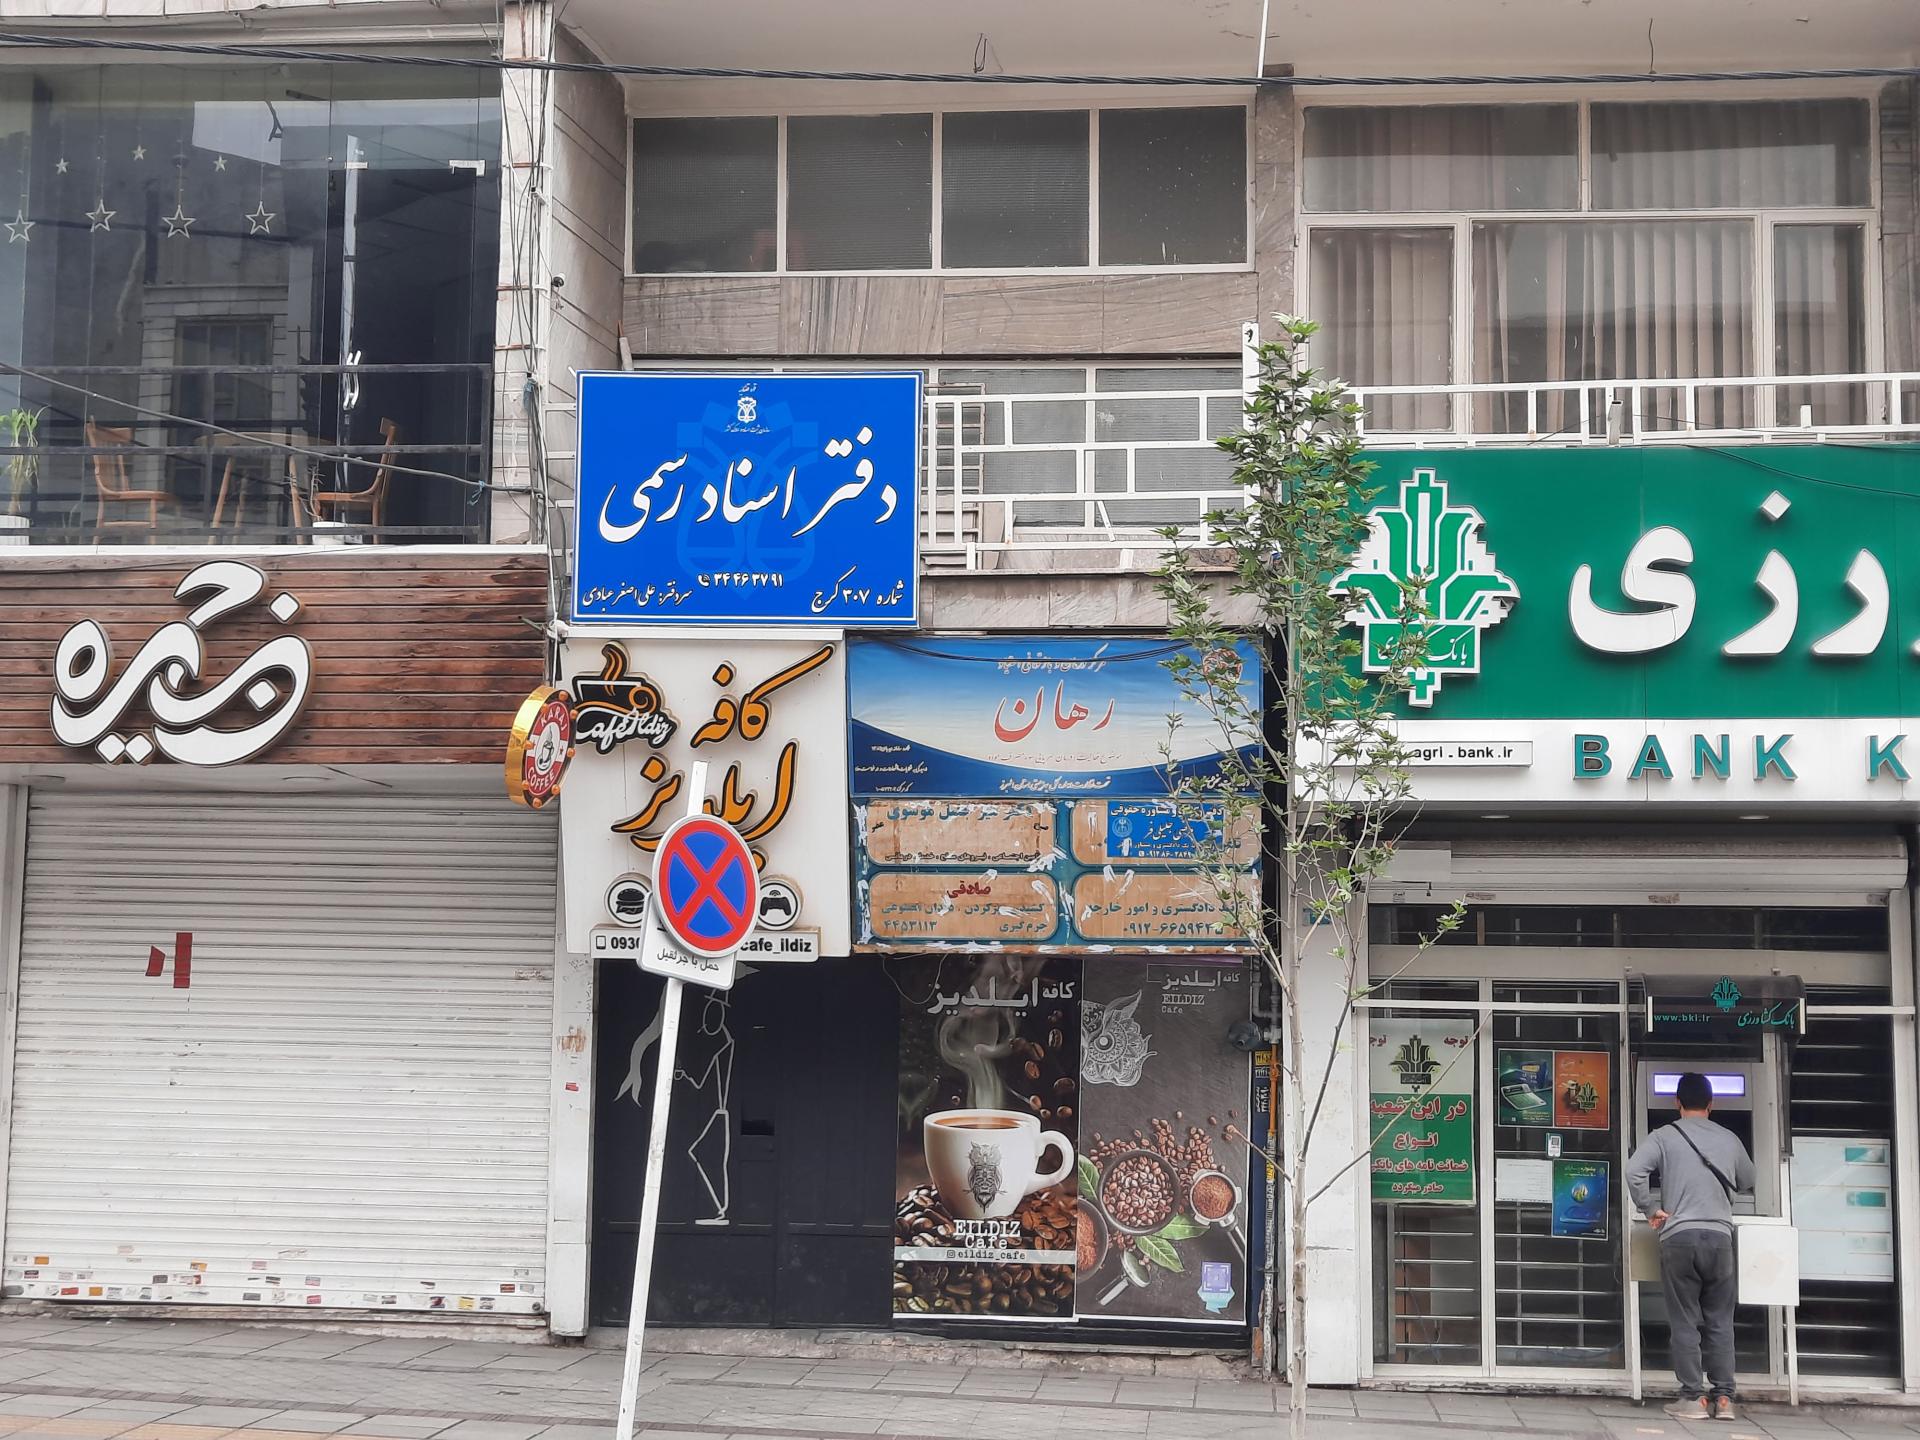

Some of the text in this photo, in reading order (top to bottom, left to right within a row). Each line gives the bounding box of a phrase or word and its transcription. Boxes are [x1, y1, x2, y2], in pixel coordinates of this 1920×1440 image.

[598, 426, 898, 543] دفتر اسناد رسمی
[611, 581, 638, 606] اصغر
[637, 584, 656, 607] علی
[811, 565, 904, 613] شماره ۳۰۷ کرج
[540, 706, 568, 731] KARAJ
[1572, 733, 1798, 781] BANK
[527, 766, 555, 792] COFFEE
[887, 806, 935, 821] موسوی
[1110, 803, 1139, 816] حقوقی
[947, 880, 992, 899] صادقی
[1126, 902, 1149, 916] امور
[1161, 901, 1214, 916] دادگستری
[691, 955, 698, 968] با
[700, 960, 719, 971] حمل
[1162, 969, 1240, 991] کافه ایلدیز
[927, 976, 1075, 1017] کافه ایلدیز
[1162, 994, 1205, 1005] EILDIZ
[1654, 1013, 1711, 1022] www.bki.ir
[1738, 1002, 1799, 1029] بانک کشاورزی
[1370, 1035, 1469, 1048] توجه توج
[1411, 1096, 1440, 1120] این
[1444, 1100, 1467, 1120] در
[1393, 1132, 1438, 1150] انواع
[1394, 1158, 1414, 1173] های
[1416, 1158, 1435, 1171] نامه
[1436, 1159, 1468, 1171] ضمانت
[1422, 1182, 1444, 1194] صادر
[953, 1220, 1020, 1238] EILDIZ
[965, 1234, 1008, 1249] Cafe
